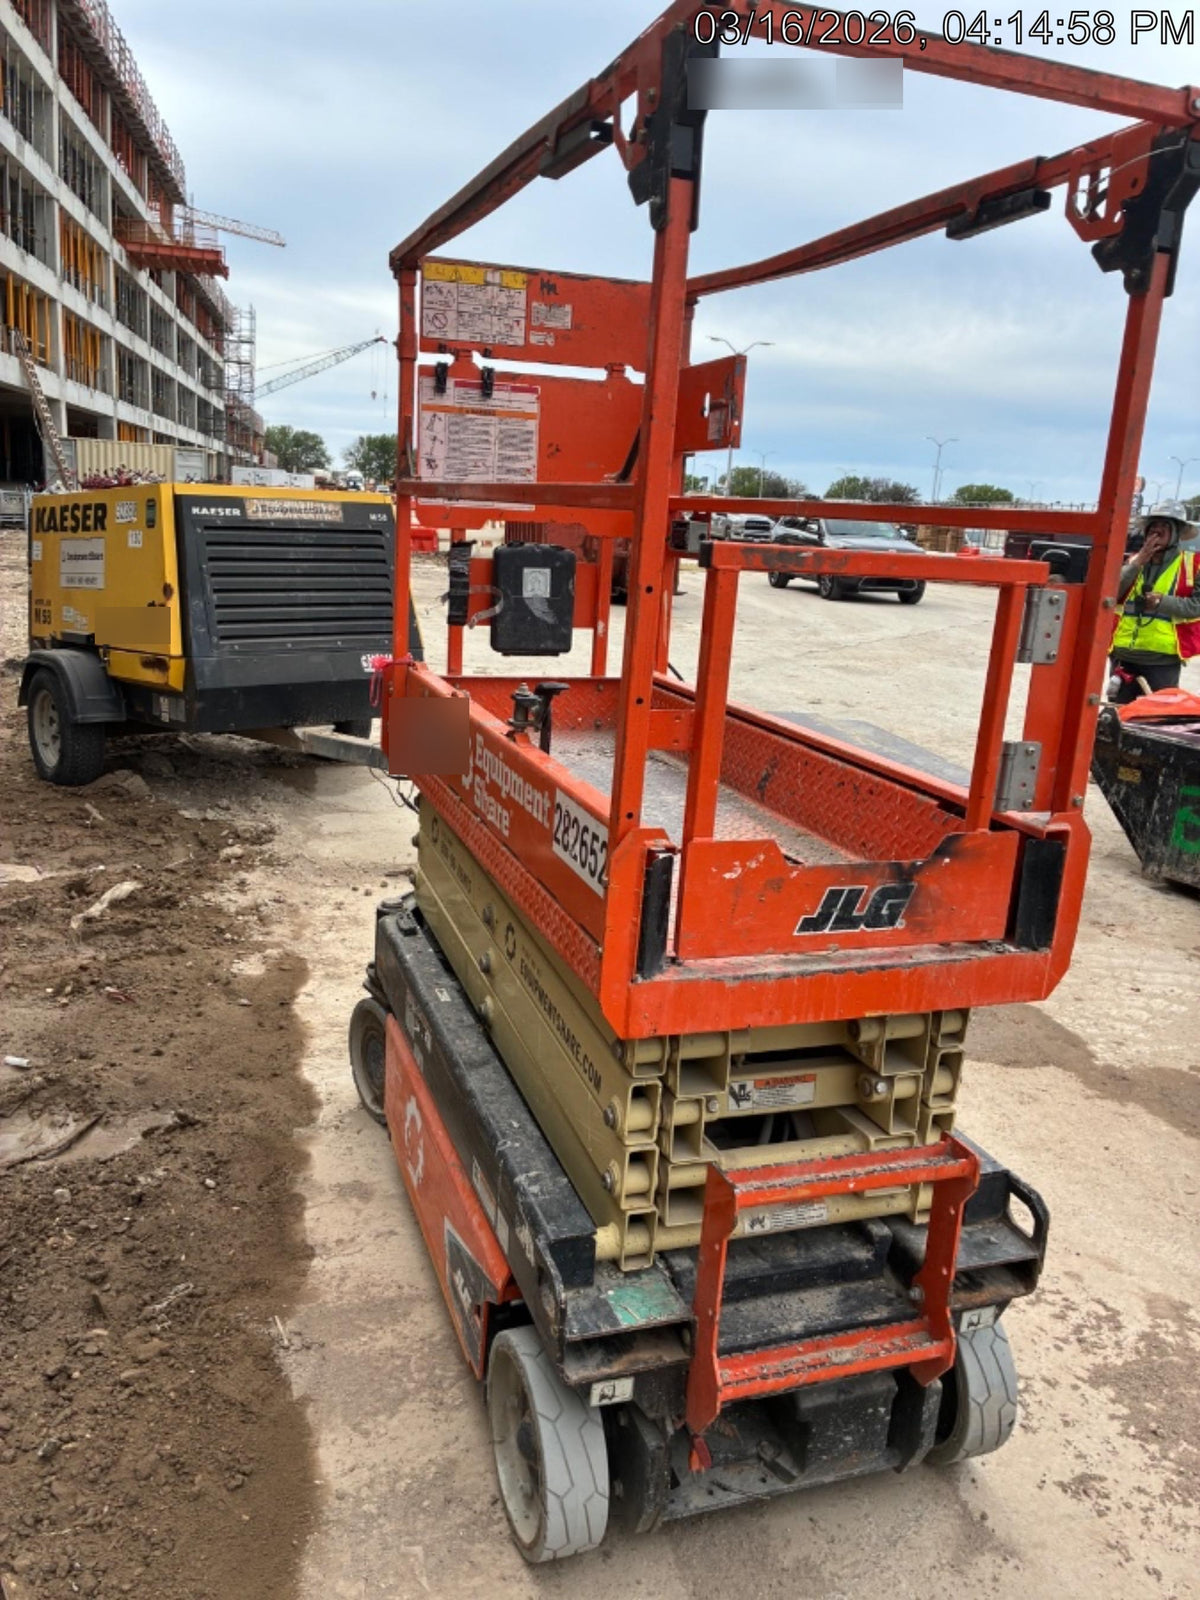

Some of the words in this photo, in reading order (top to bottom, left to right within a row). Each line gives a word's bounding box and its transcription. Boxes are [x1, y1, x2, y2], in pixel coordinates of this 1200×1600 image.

[35, 502, 107, 533] KAESER
[191, 506, 241, 517] KAESER
[474, 773, 510, 838] Share
[475, 732, 552, 830] Equipment
[553, 801, 608, 886] 282652
[793, 882, 916, 935] JLG
